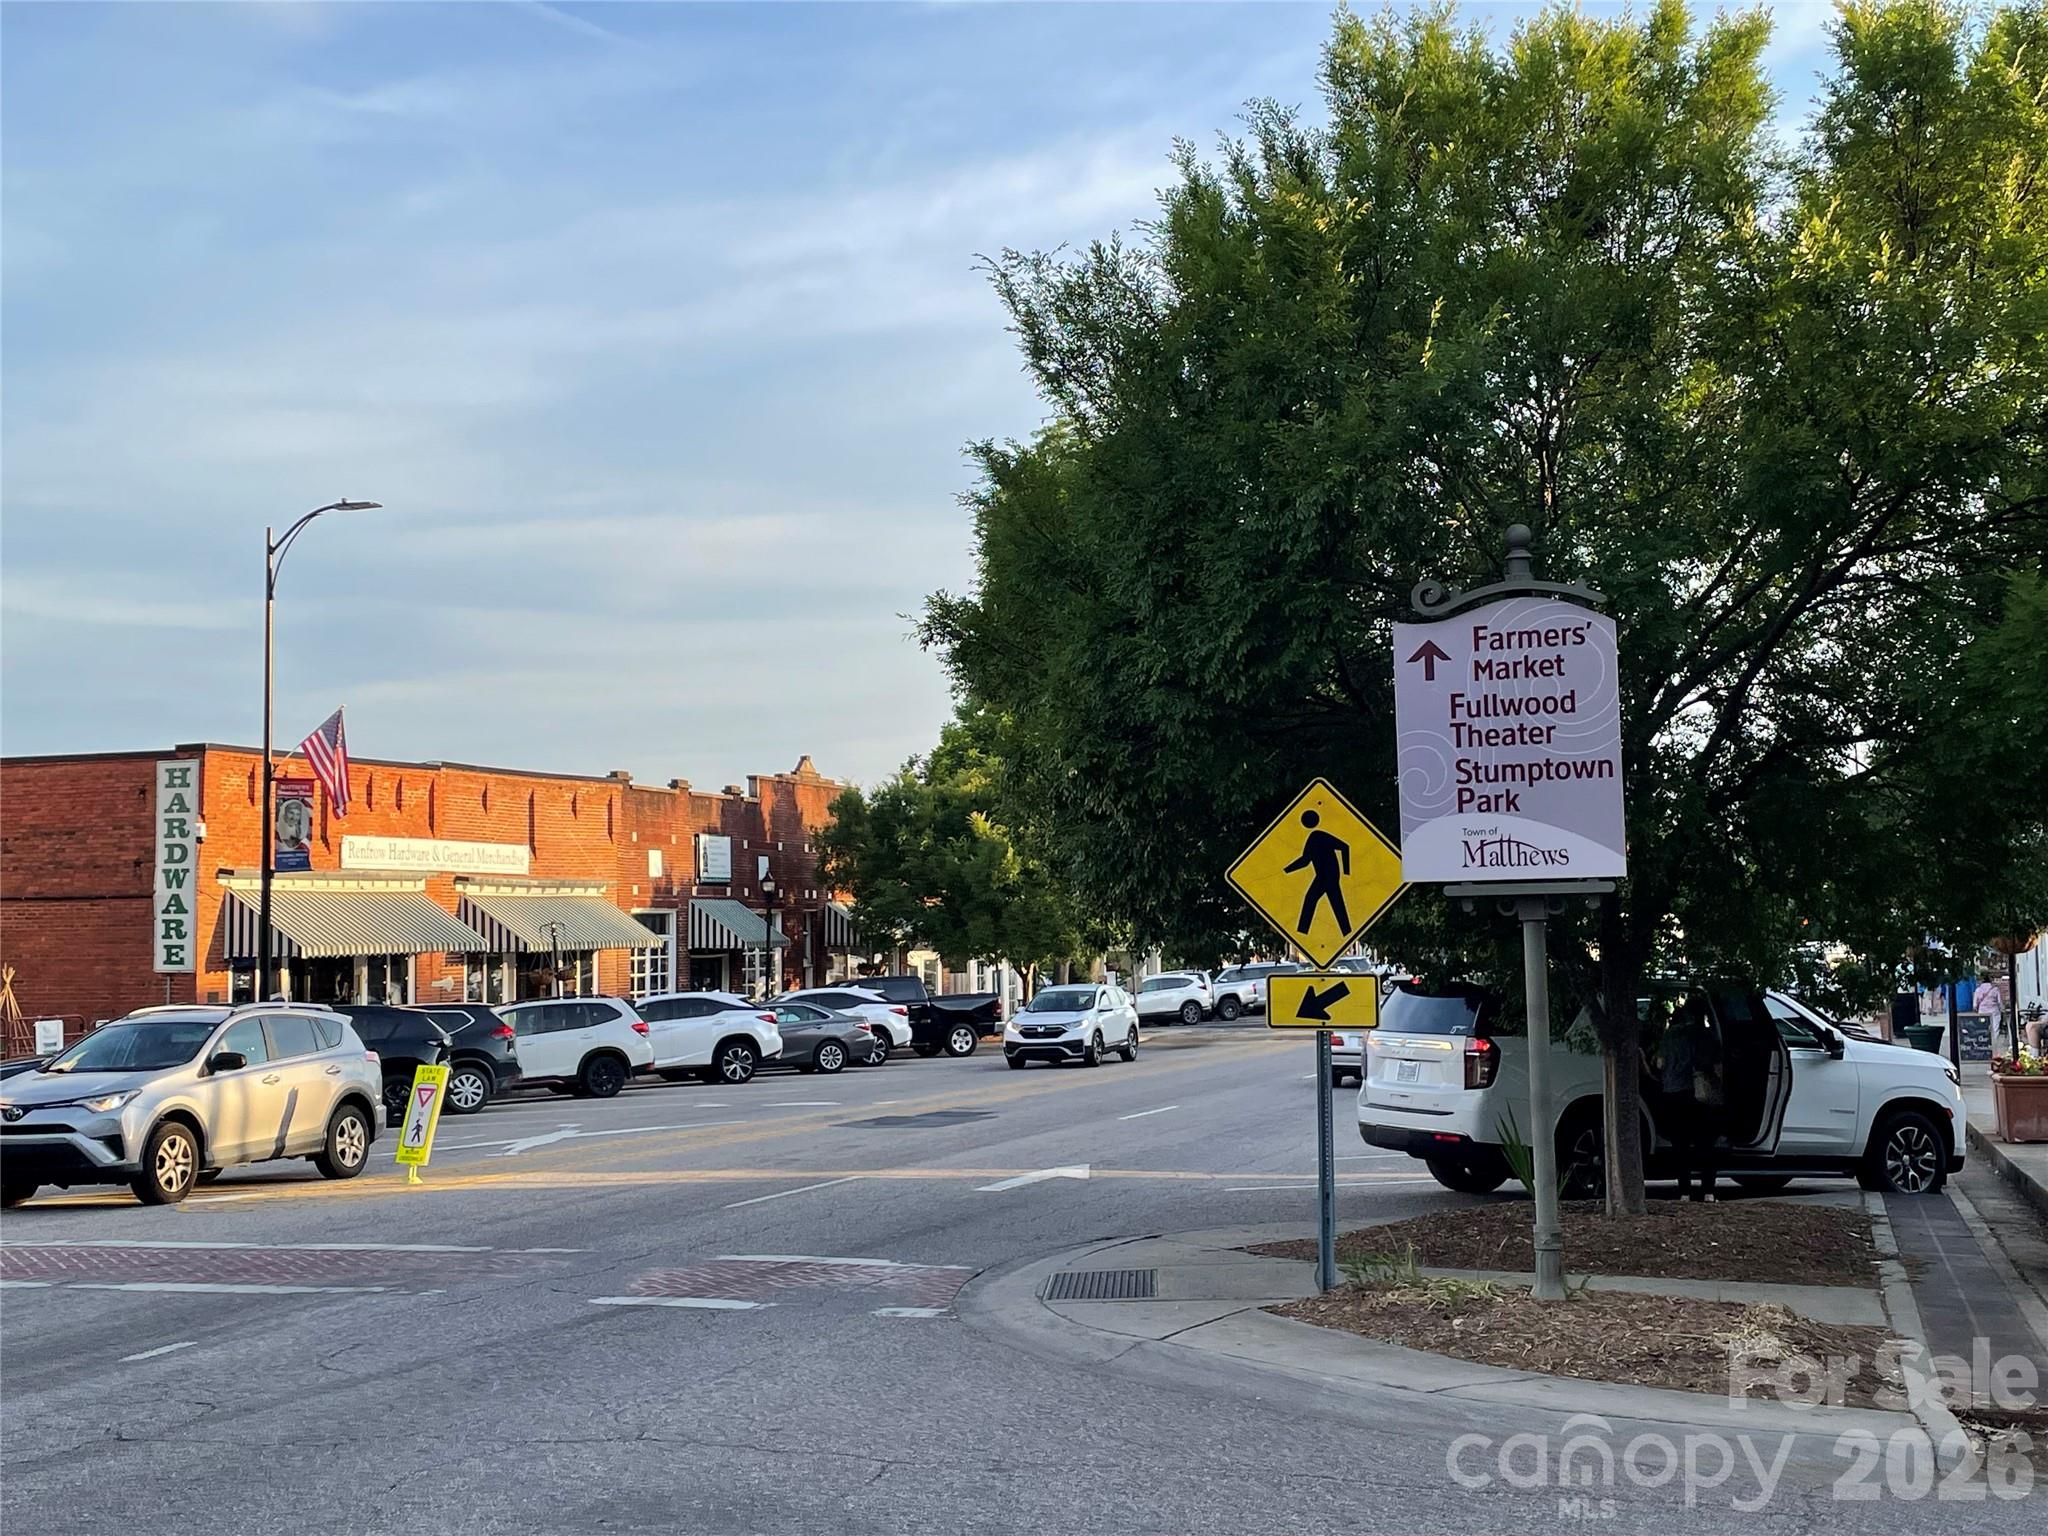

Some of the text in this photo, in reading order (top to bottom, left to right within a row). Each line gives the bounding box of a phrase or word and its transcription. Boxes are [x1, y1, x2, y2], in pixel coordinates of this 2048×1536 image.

[1473, 621, 1592, 652] Farmers'
[1473, 654, 1566, 682] Market
[1450, 689, 1576, 719] Fullwood
[1449, 722, 1557, 748] Theater
[1455, 758, 1614, 787] Stumptown
[1457, 787, 1521, 814] Park
[1462, 826, 1499, 836] Town of
[347, 840, 525, 866] Renfrow Hardware & General Merchandise
[1462, 833, 1570, 867] Matthews
[161, 767, 191, 966] HARDWARE
